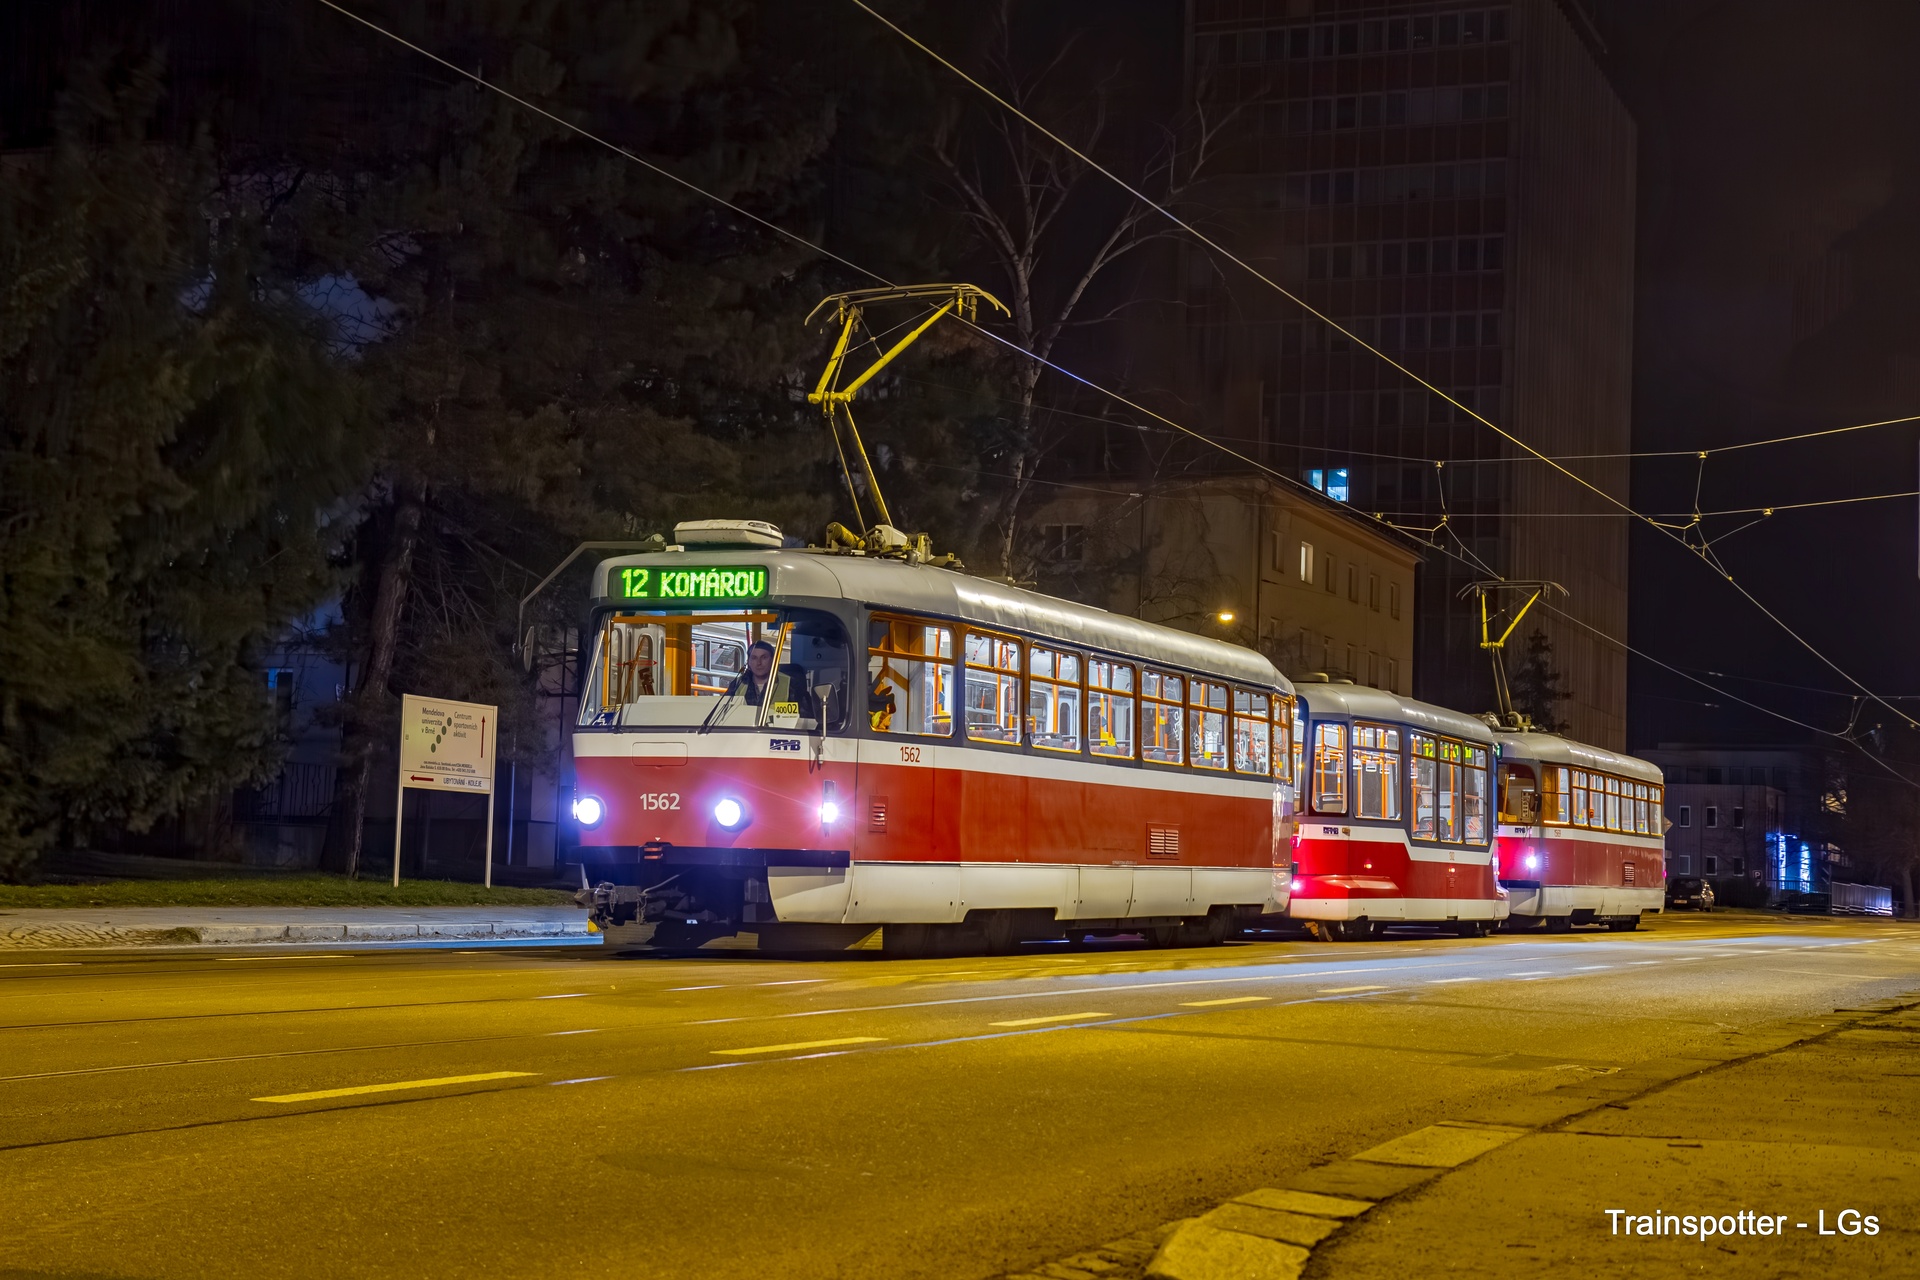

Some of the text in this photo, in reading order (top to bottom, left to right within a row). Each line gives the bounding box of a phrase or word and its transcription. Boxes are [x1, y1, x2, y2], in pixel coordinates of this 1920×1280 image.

[621, 567, 765, 598] 12 KOMÁROV
[422, 707, 445, 717] Mendelova
[454, 711, 472, 720] Centrum
[421, 718, 443, 726] univerzita
[453, 721, 478, 731] sportovních
[424, 726, 436, 735] Brně
[900, 746, 921, 763] 1562
[639, 792, 681, 811] 1562
